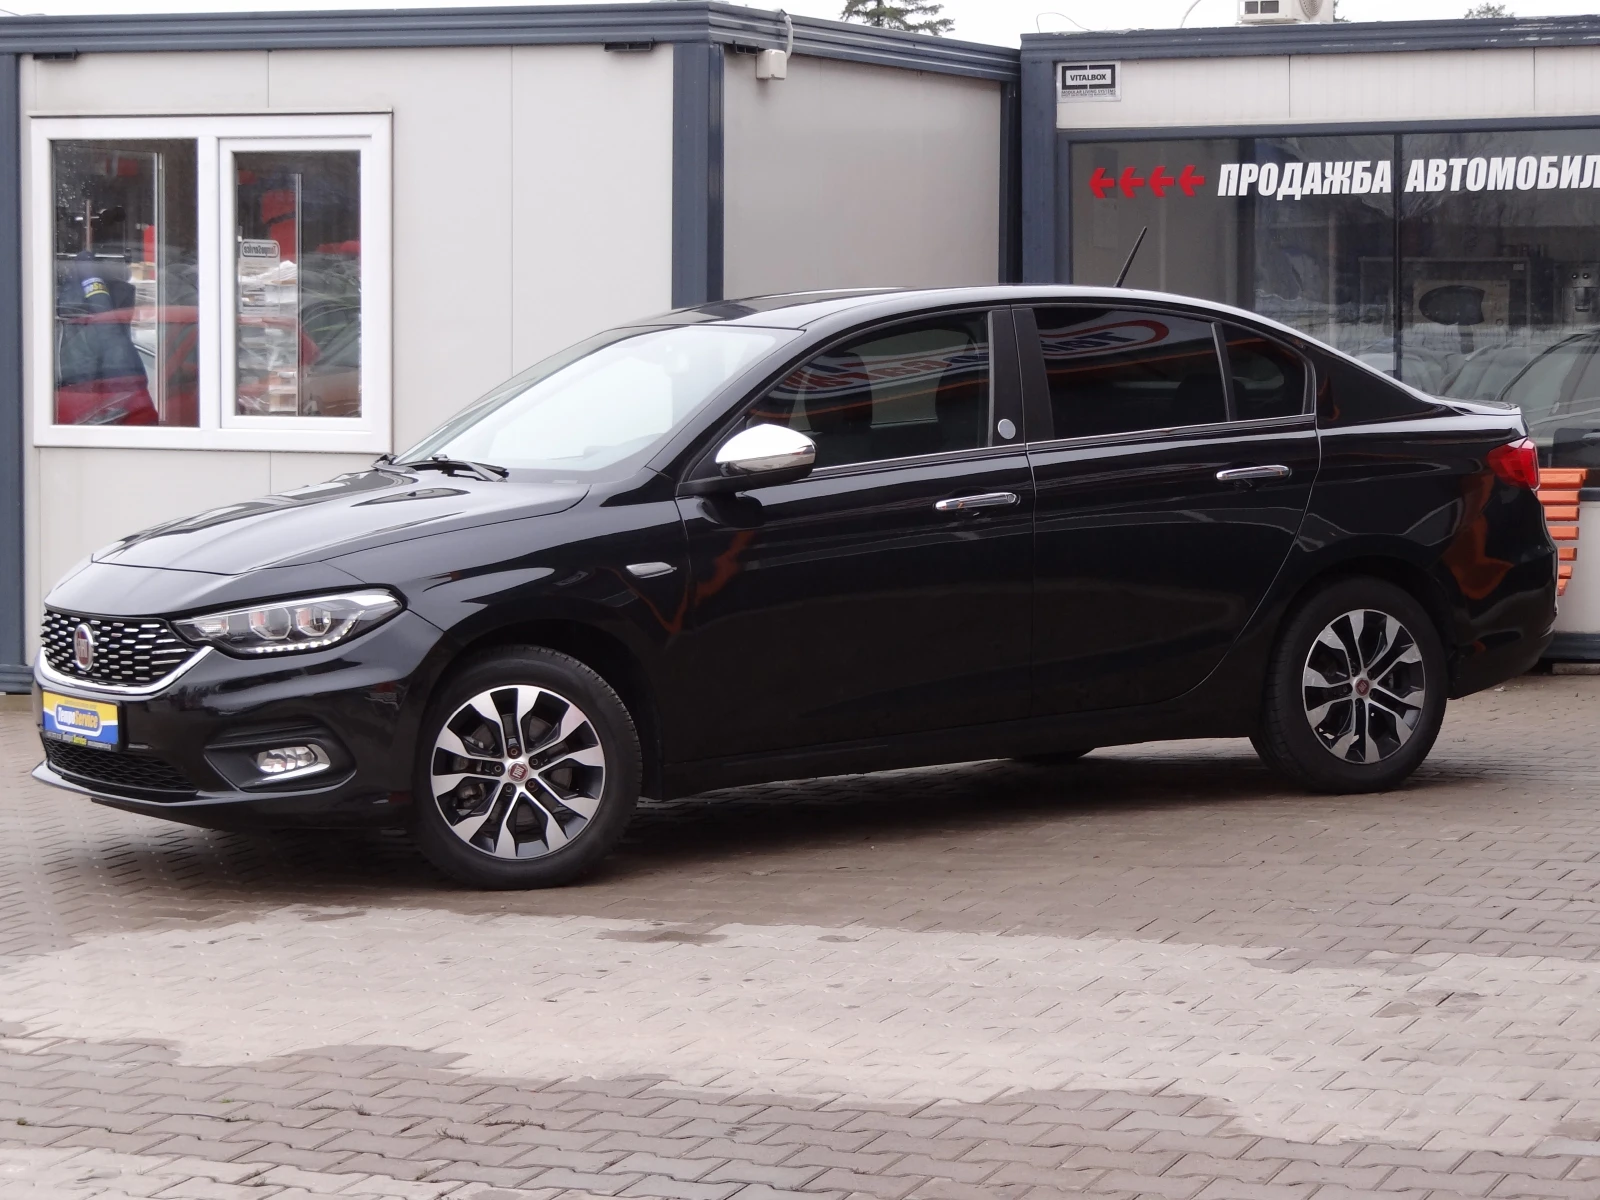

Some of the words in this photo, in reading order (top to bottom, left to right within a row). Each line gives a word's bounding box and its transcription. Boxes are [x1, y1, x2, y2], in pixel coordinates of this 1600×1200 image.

[1217, 160, 1392, 201] ПРОДАЖБА
[1404, 155, 1600, 192] АВТОМОБИЛ
[57, 706, 98, 728] TempoService
